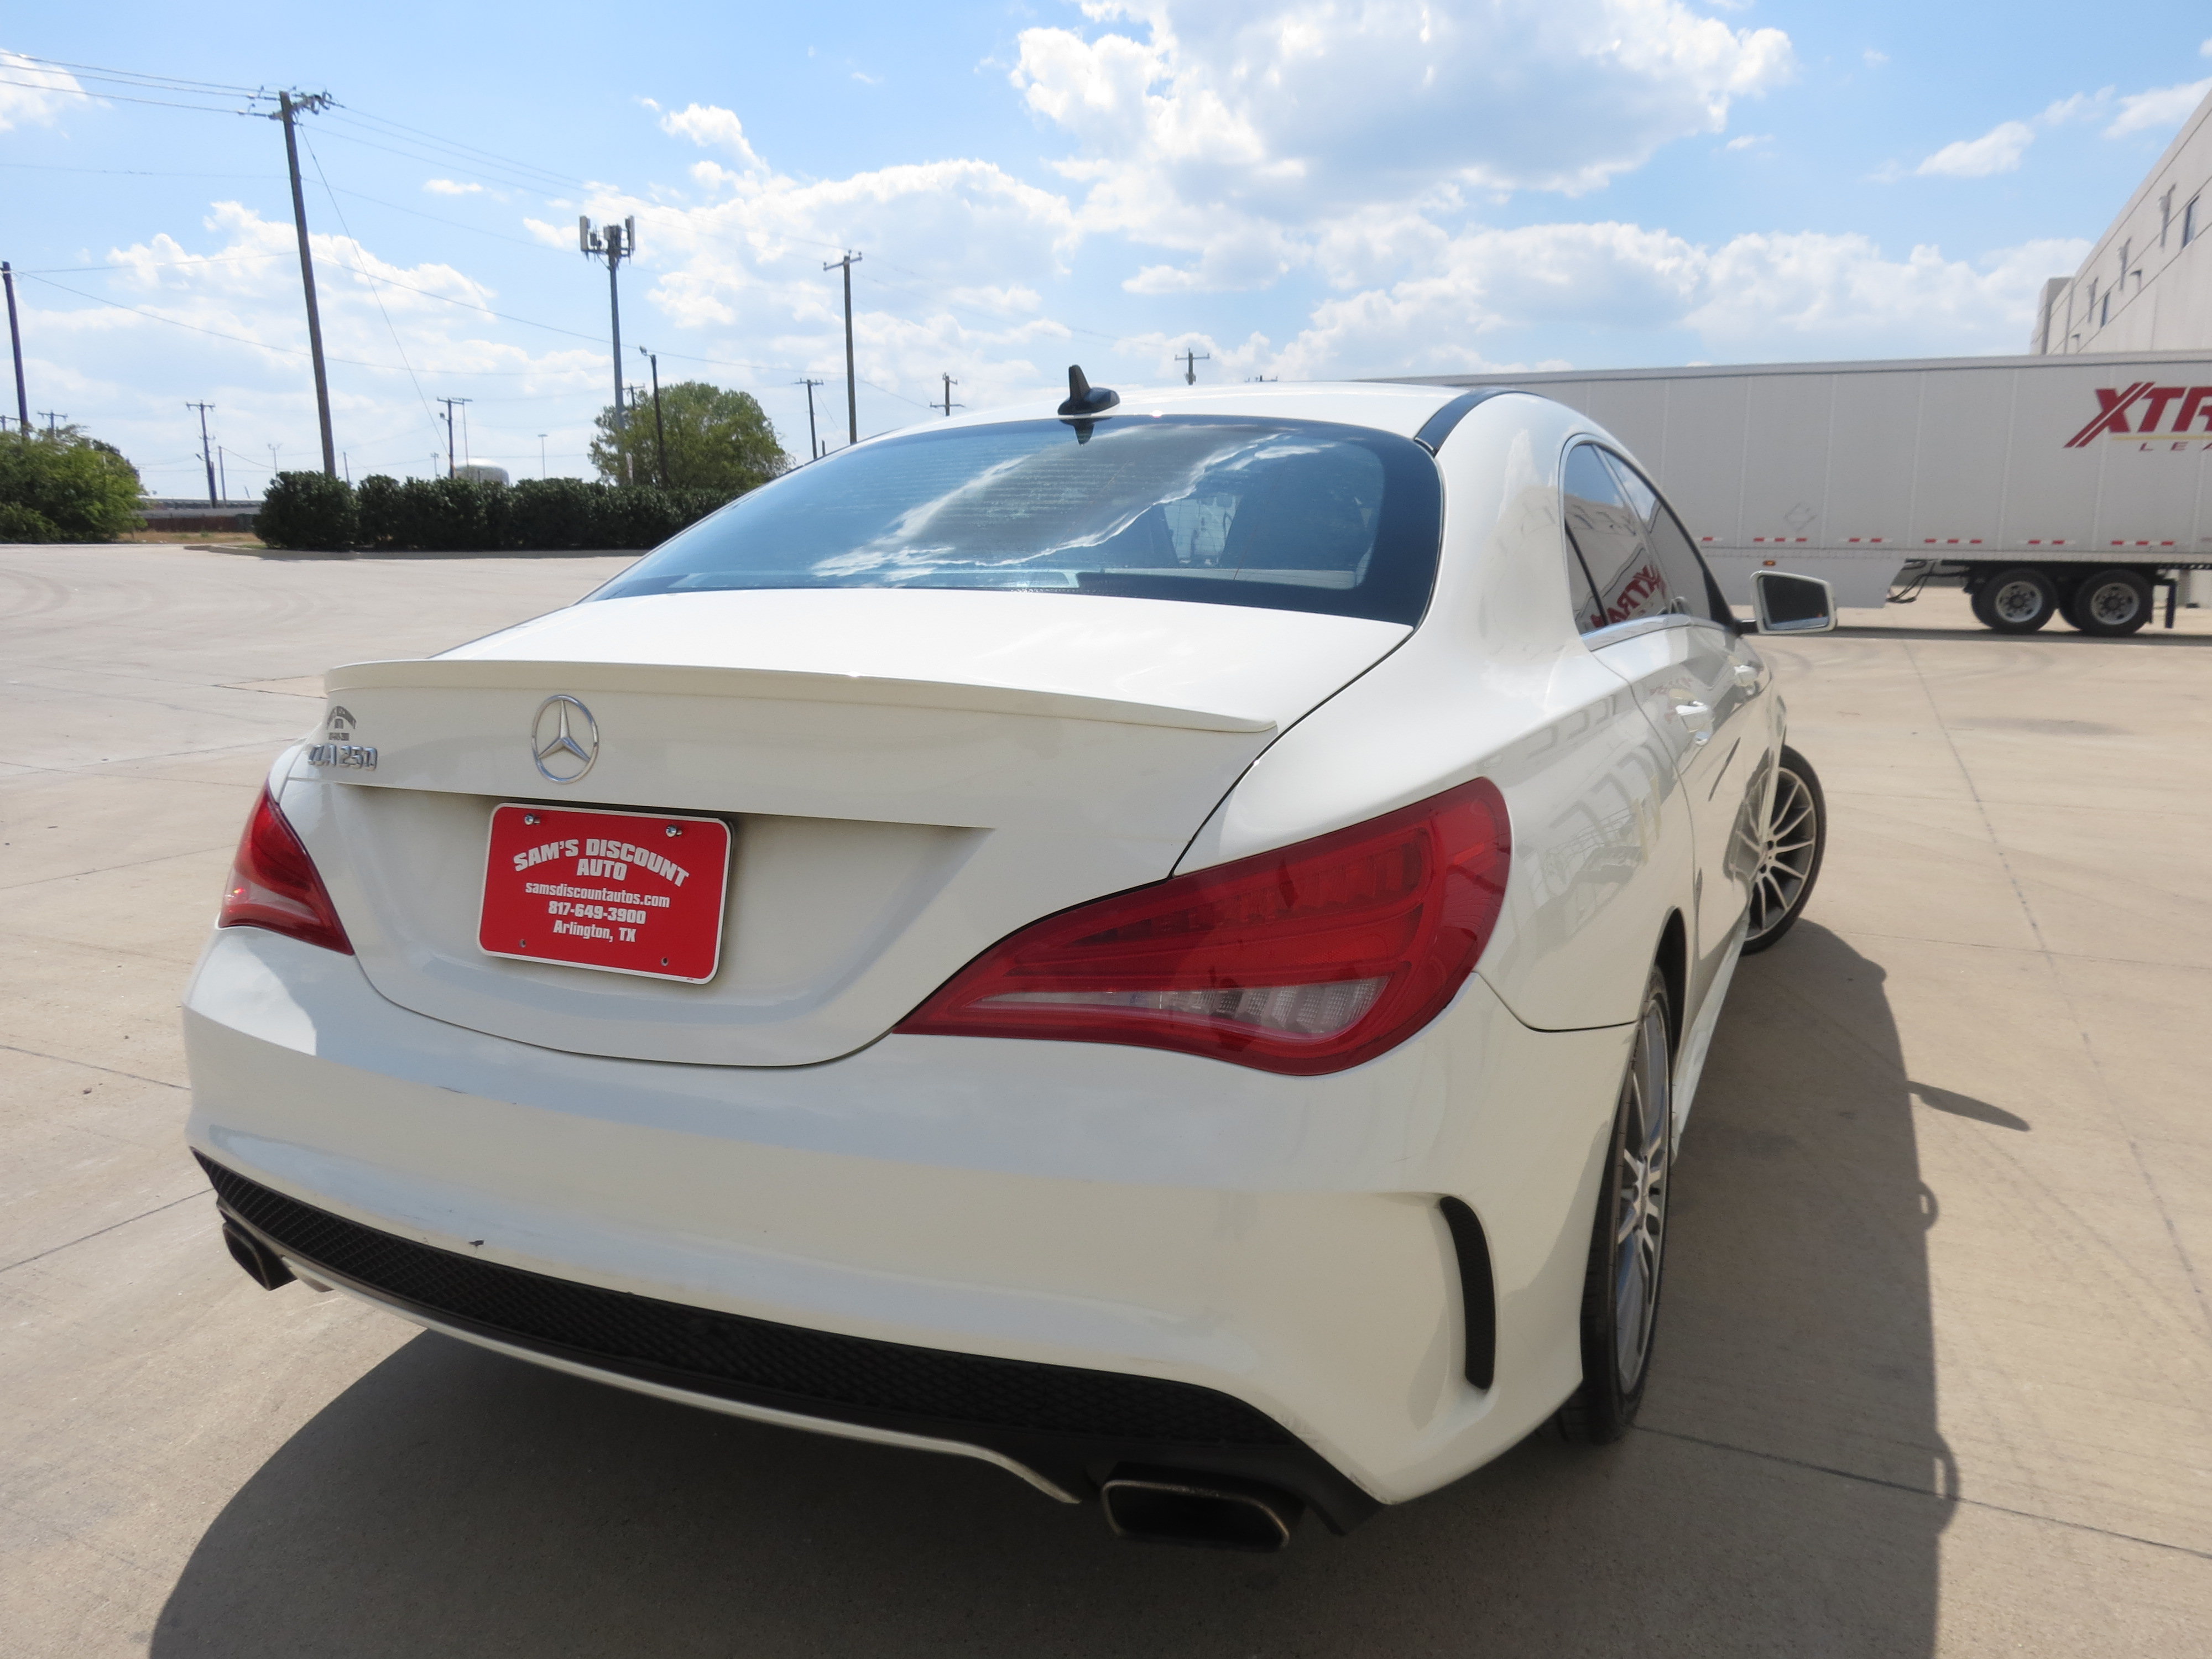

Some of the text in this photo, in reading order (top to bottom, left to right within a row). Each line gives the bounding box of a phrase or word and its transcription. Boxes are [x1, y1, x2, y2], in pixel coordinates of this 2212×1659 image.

[338, 744, 378, 772] 250
[513, 838, 690, 887] SAM'S DISCOUNT
[576, 858, 628, 881] AUTO
[525, 882, 670, 908] samsdiscountautos.com
[548, 900, 646, 925] 817-649-3900
[553, 920, 637, 943] Arlington, TX
